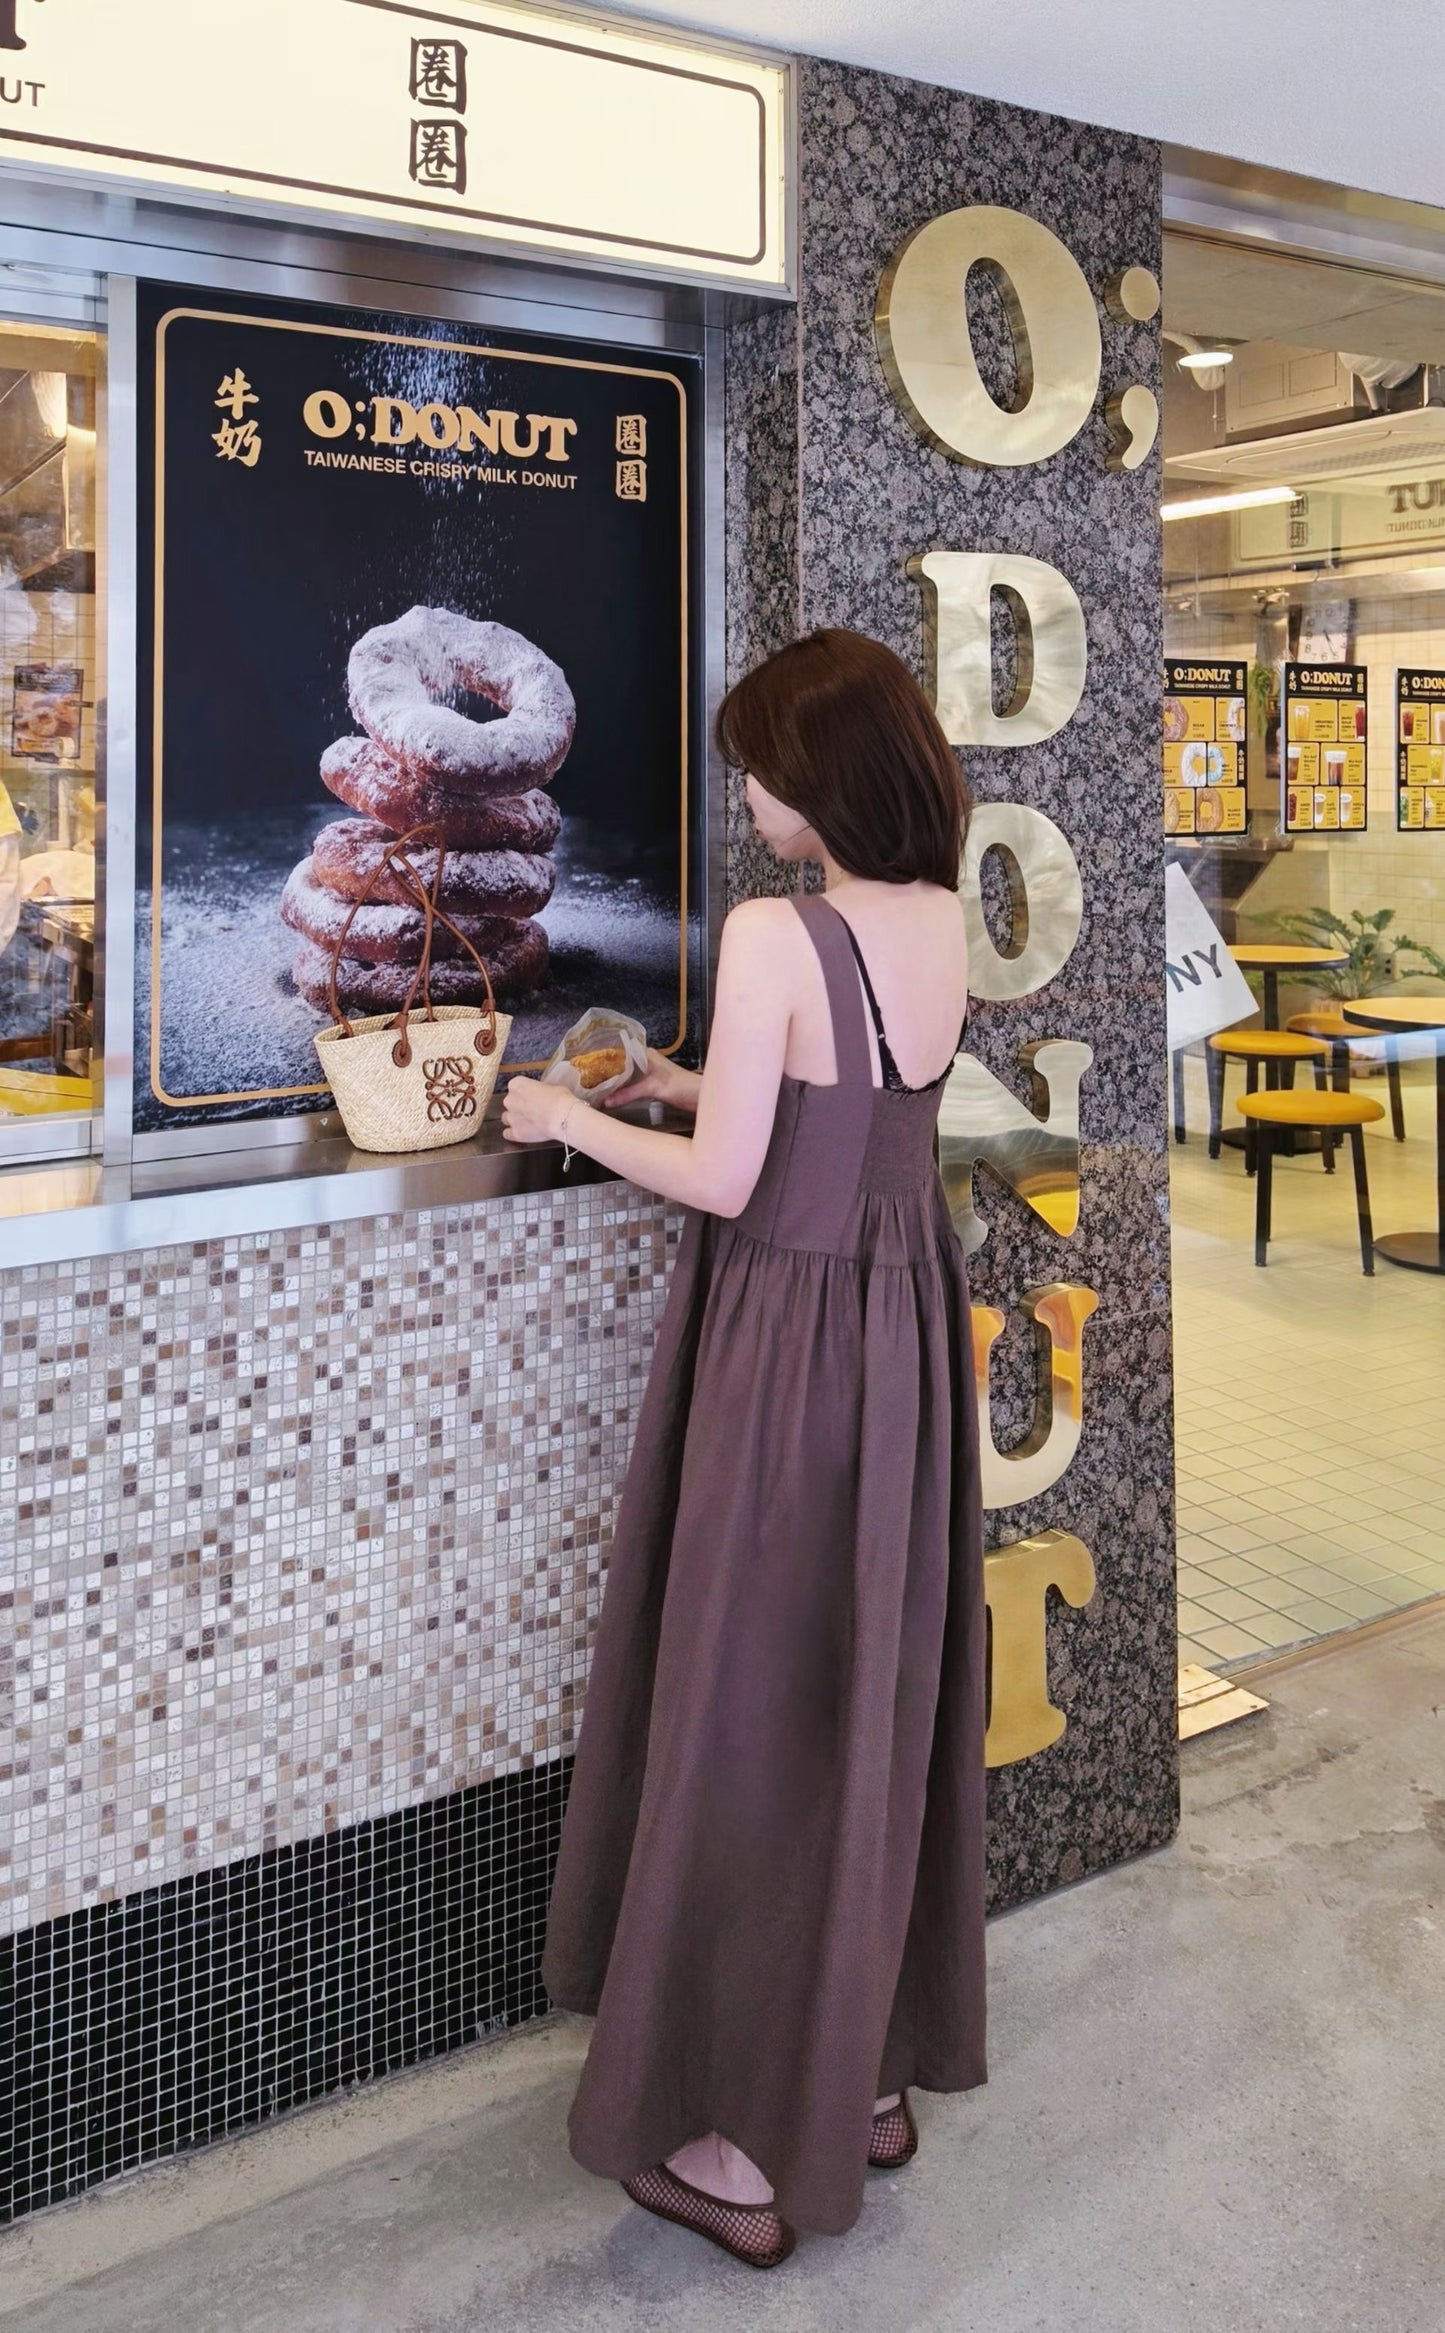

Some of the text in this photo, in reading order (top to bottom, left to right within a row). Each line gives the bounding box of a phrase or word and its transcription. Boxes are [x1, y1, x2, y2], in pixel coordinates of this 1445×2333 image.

[408, 34, 468, 195] 圈圈
[212, 367, 261, 467] 牛奶
[615, 414, 647, 502] 圈圈
[304, 450, 578, 490] TAIWANESE CRISPY MILK DONUT
